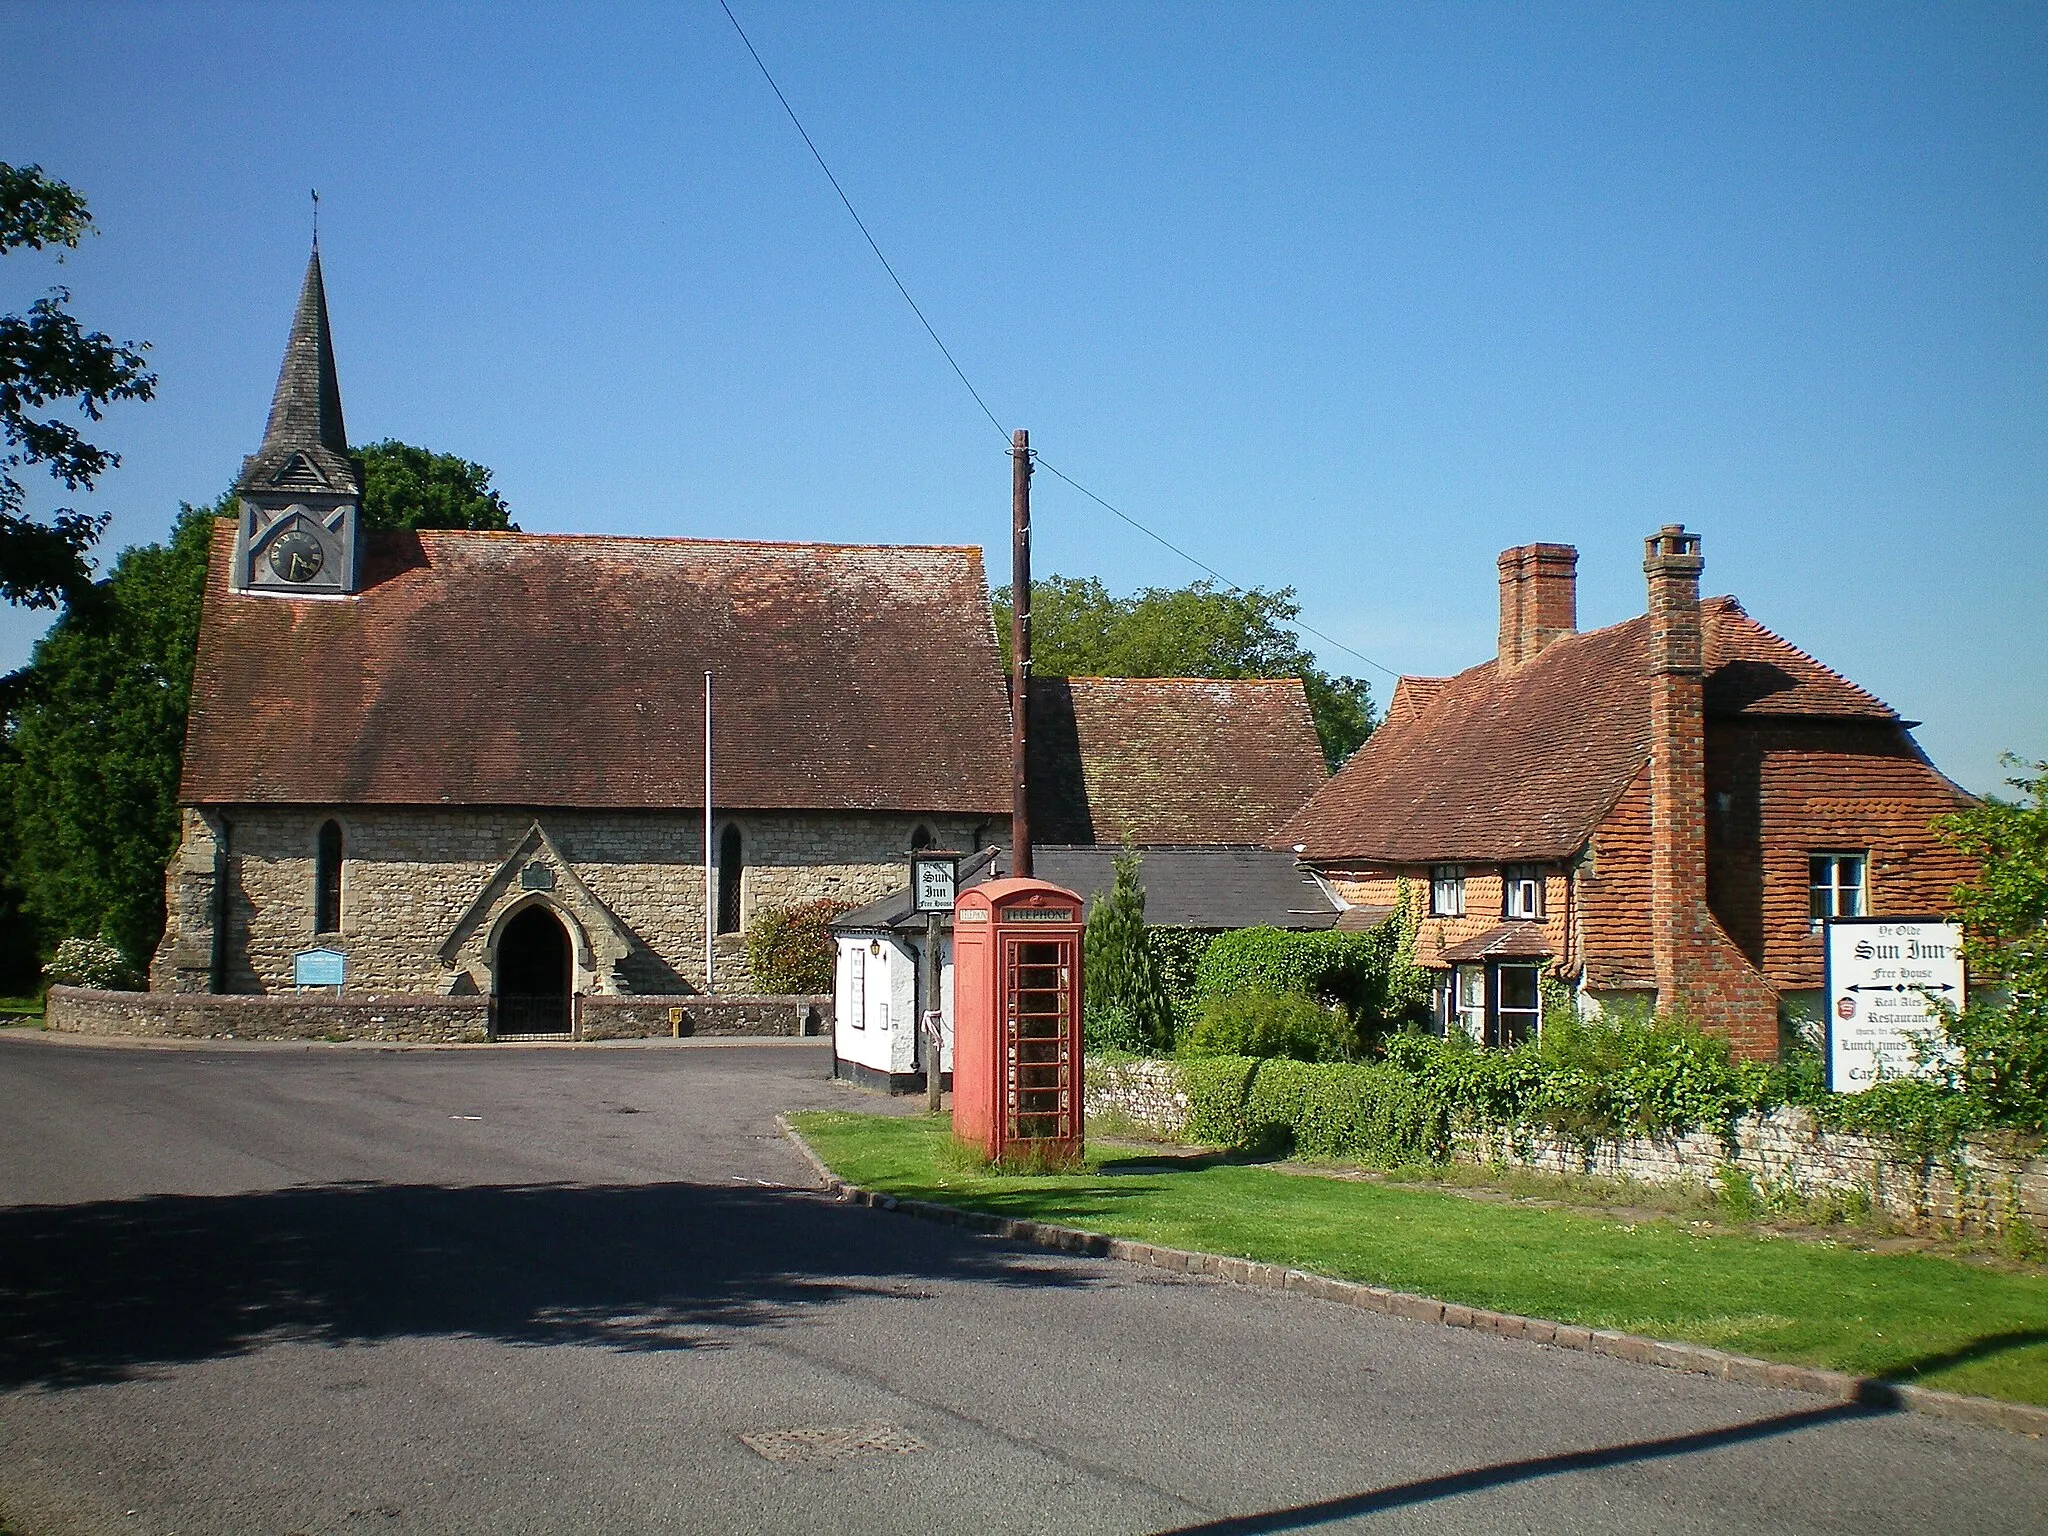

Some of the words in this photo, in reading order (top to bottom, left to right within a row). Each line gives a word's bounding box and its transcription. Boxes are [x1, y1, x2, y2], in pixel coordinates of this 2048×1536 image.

[922, 871, 948, 883] Sun
[924, 885, 946, 898] Inn
[918, 900, 933, 908] Free
[1006, 909, 1069, 920] TELEPHONE
[1878, 925, 1893, 938] Ye
[1895, 925, 1922, 936] Olde
[1854, 939, 1900, 961] Sun
[1906, 939, 1946, 960] Inn
[1871, 968, 1897, 980] Free
[1899, 967, 1932, 979] House
[1874, 997, 1897, 1007] Real
[1899, 997, 1922, 1007] Ales
[1841, 1039, 1875, 1051] Lunch
[1878, 1040, 1907, 1051] times
[1848, 1067, 1872, 1081] Car
